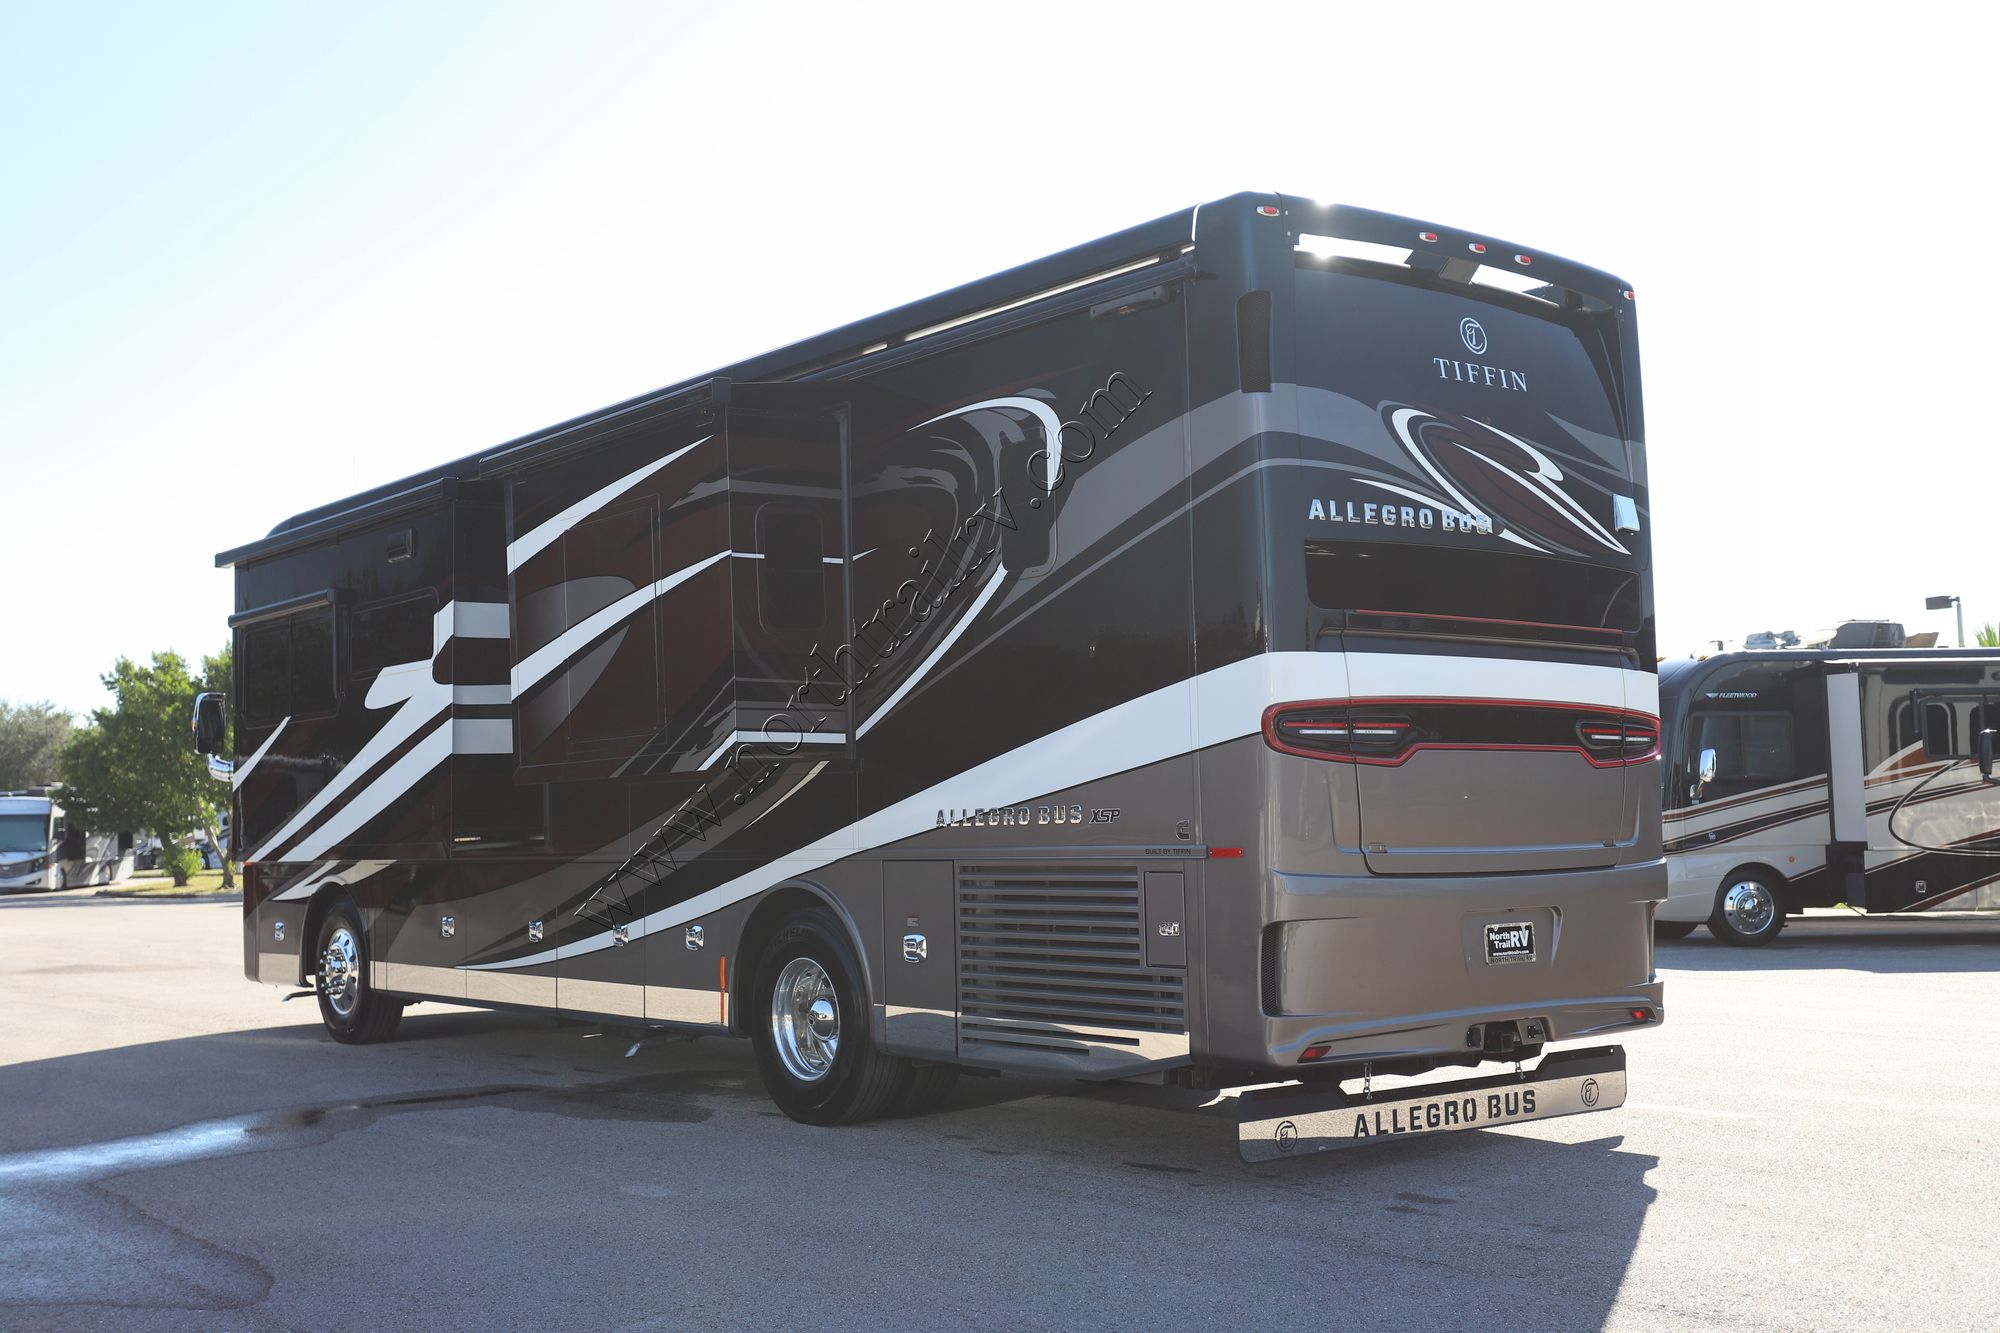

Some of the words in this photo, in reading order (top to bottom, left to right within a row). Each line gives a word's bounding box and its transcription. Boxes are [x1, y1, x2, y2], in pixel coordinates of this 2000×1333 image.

[1433, 357, 1528, 392] TIFFIN
[1308, 498, 1434, 530] ALLEGRO
[1442, 509, 1490, 535] BUS
[935, 806, 1030, 828] ALLEGRO
[1038, 804, 1082, 825] BUS
[1089, 808, 1121, 825] XSP
[1489, 932, 1510, 941] North
[1494, 940, 1511, 949] Trail
[1510, 929, 1529, 948] RV
[1353, 1097, 1477, 1139] ALLEGRO
[1488, 1090, 1536, 1119] BUS
